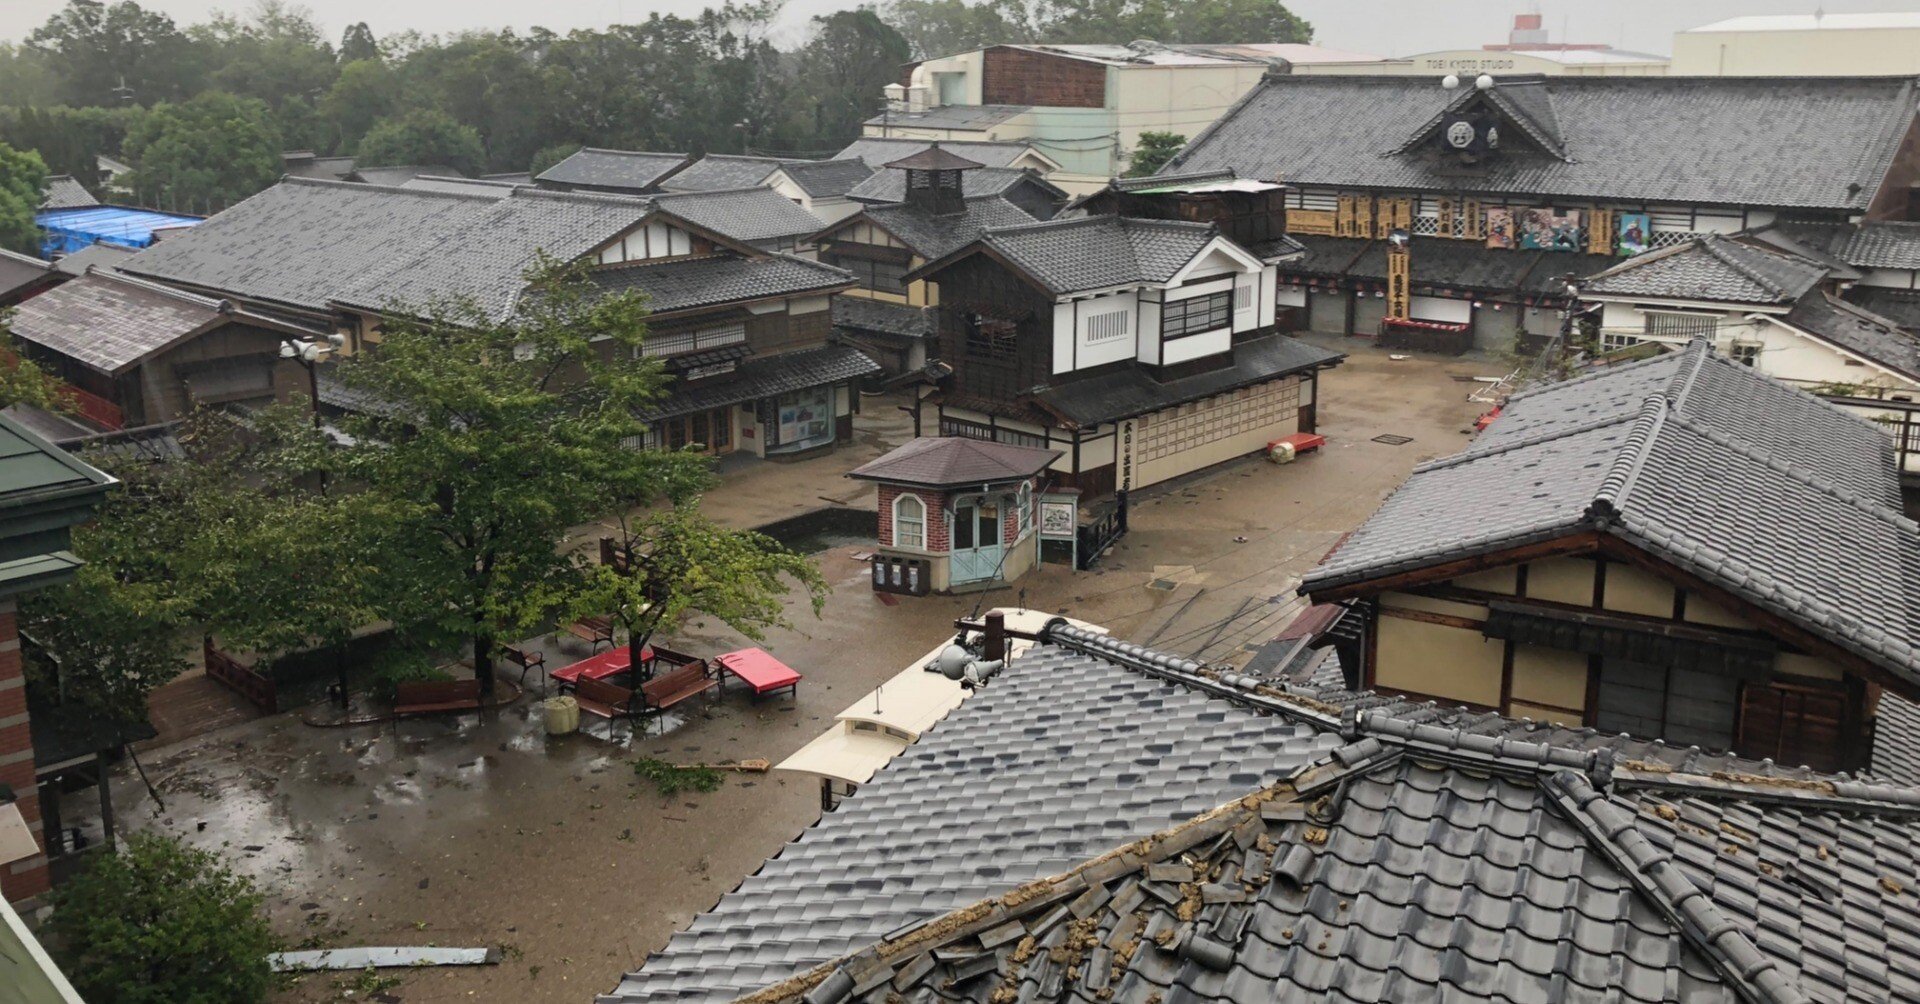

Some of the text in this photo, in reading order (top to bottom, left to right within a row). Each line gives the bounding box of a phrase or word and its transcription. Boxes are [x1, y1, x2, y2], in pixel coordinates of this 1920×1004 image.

[1426, 59, 1514, 70] TOEI KYOTO STUDIO
